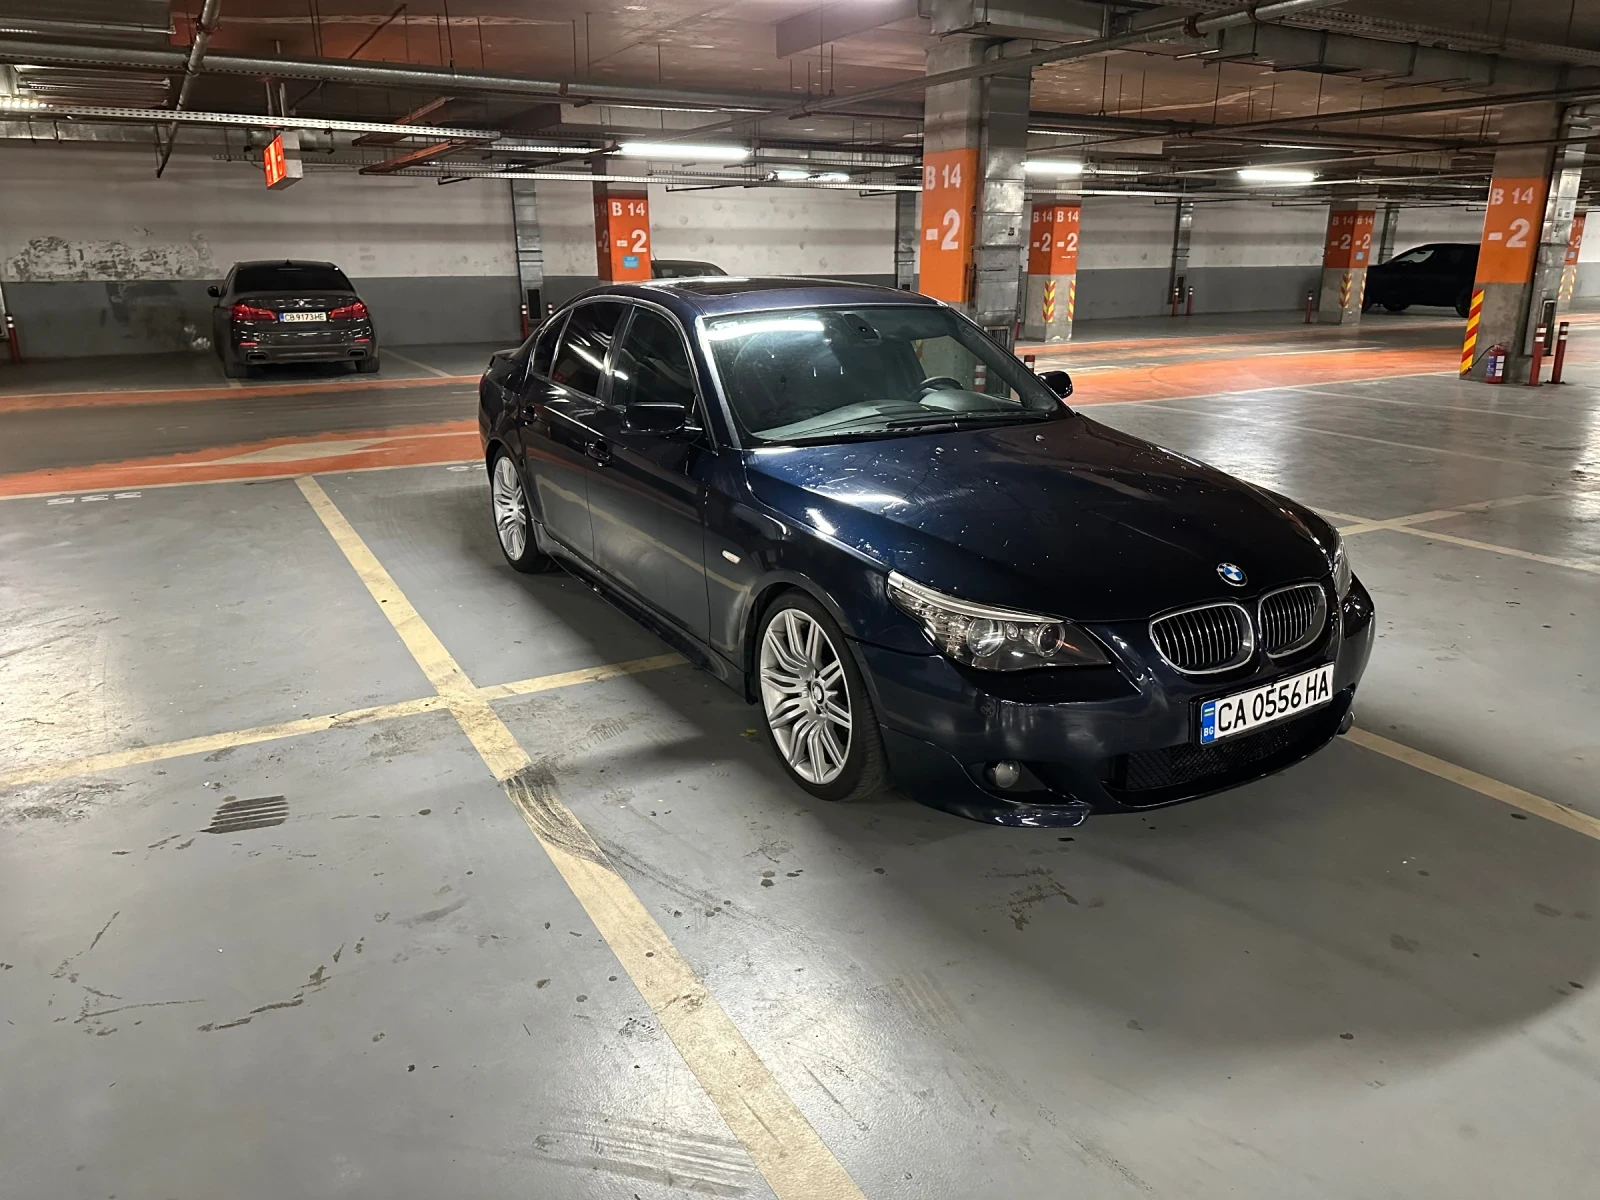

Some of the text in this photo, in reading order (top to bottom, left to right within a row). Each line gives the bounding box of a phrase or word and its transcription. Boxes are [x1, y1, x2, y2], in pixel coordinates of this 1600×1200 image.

[925, 163, 961, 190] B 14
[1491, 187, 1534, 205] B 14
[611, 202, 645, 216] B 14
[1033, 211, 1052, 222] B 14
[1057, 211, 1079, 222] B 14
[926, 208, 960, 250] -2
[1488, 218, 1530, 248] -2
[616, 229, 647, 252] -2
[1033, 232, 1051, 251] -2
[1057, 232, 1077, 251] -2
[1331, 234, 1351, 249] -2
[1356, 233, 1370, 249] -2
[1218, 670, 1329, 732] CA 0556 HA
[1203, 726, 1214, 737] BG
